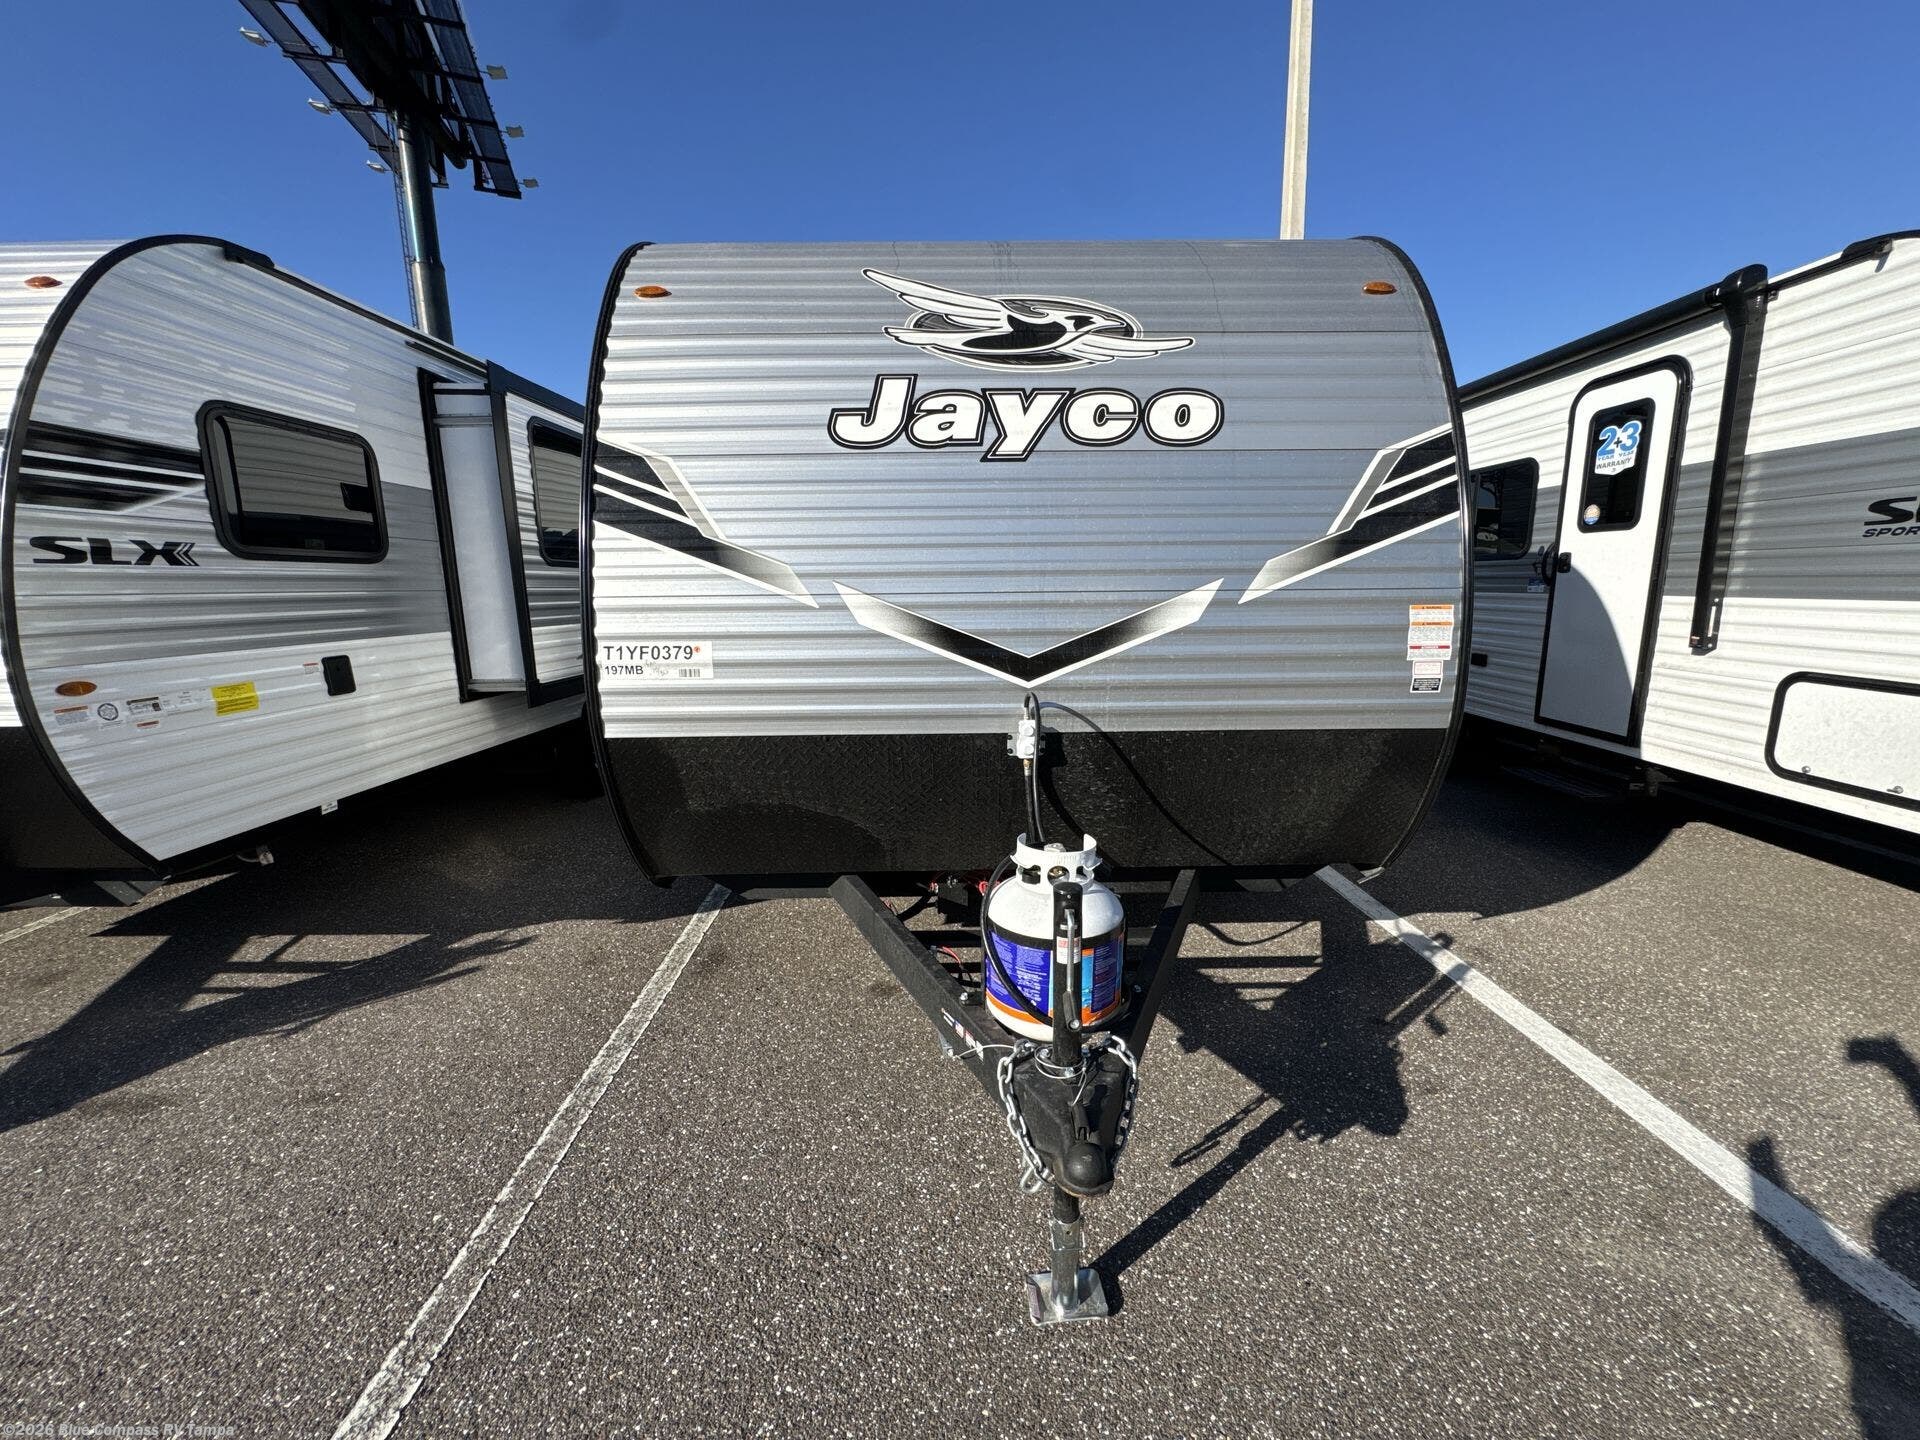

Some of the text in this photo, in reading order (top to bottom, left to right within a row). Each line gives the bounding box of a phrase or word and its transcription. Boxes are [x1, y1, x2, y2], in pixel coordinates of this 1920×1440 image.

[827, 374, 1225, 462] Jayco
[1596, 457, 1632, 469] WARRANTY
[1864, 496, 1920, 525] S
[30, 536, 199, 566] SLX
[603, 646, 694, 660] T1YF0379
[605, 666, 644, 675] 197MB
